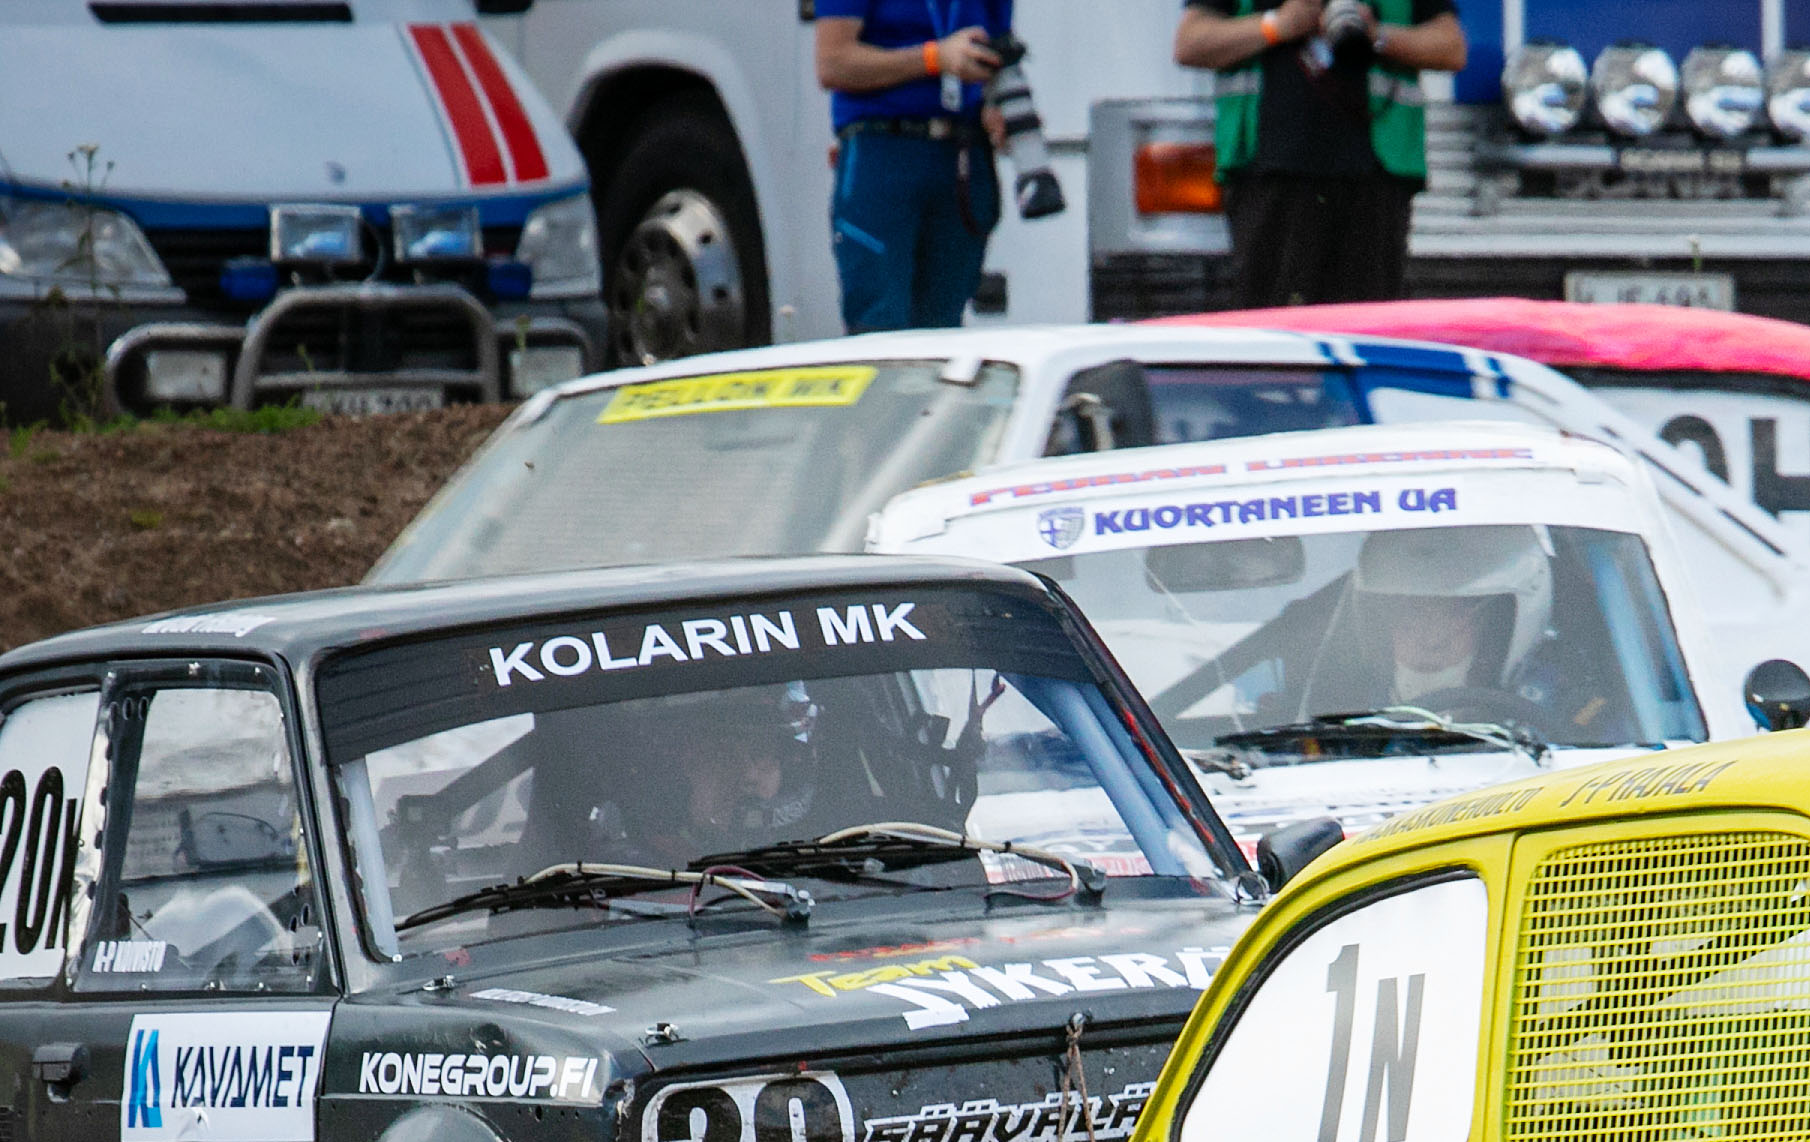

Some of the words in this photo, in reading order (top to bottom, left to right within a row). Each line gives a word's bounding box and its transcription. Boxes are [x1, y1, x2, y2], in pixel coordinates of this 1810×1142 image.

[1095, 487, 1382, 535] KUORTANEEN
[1399, 488, 1457, 513] UA
[489, 611, 800, 687] KOLARIN
[816, 602, 927, 646] MK
[171, 1045, 314, 1108] KAVAMET
[359, 1052, 598, 1098] KONEGROUP.FI
